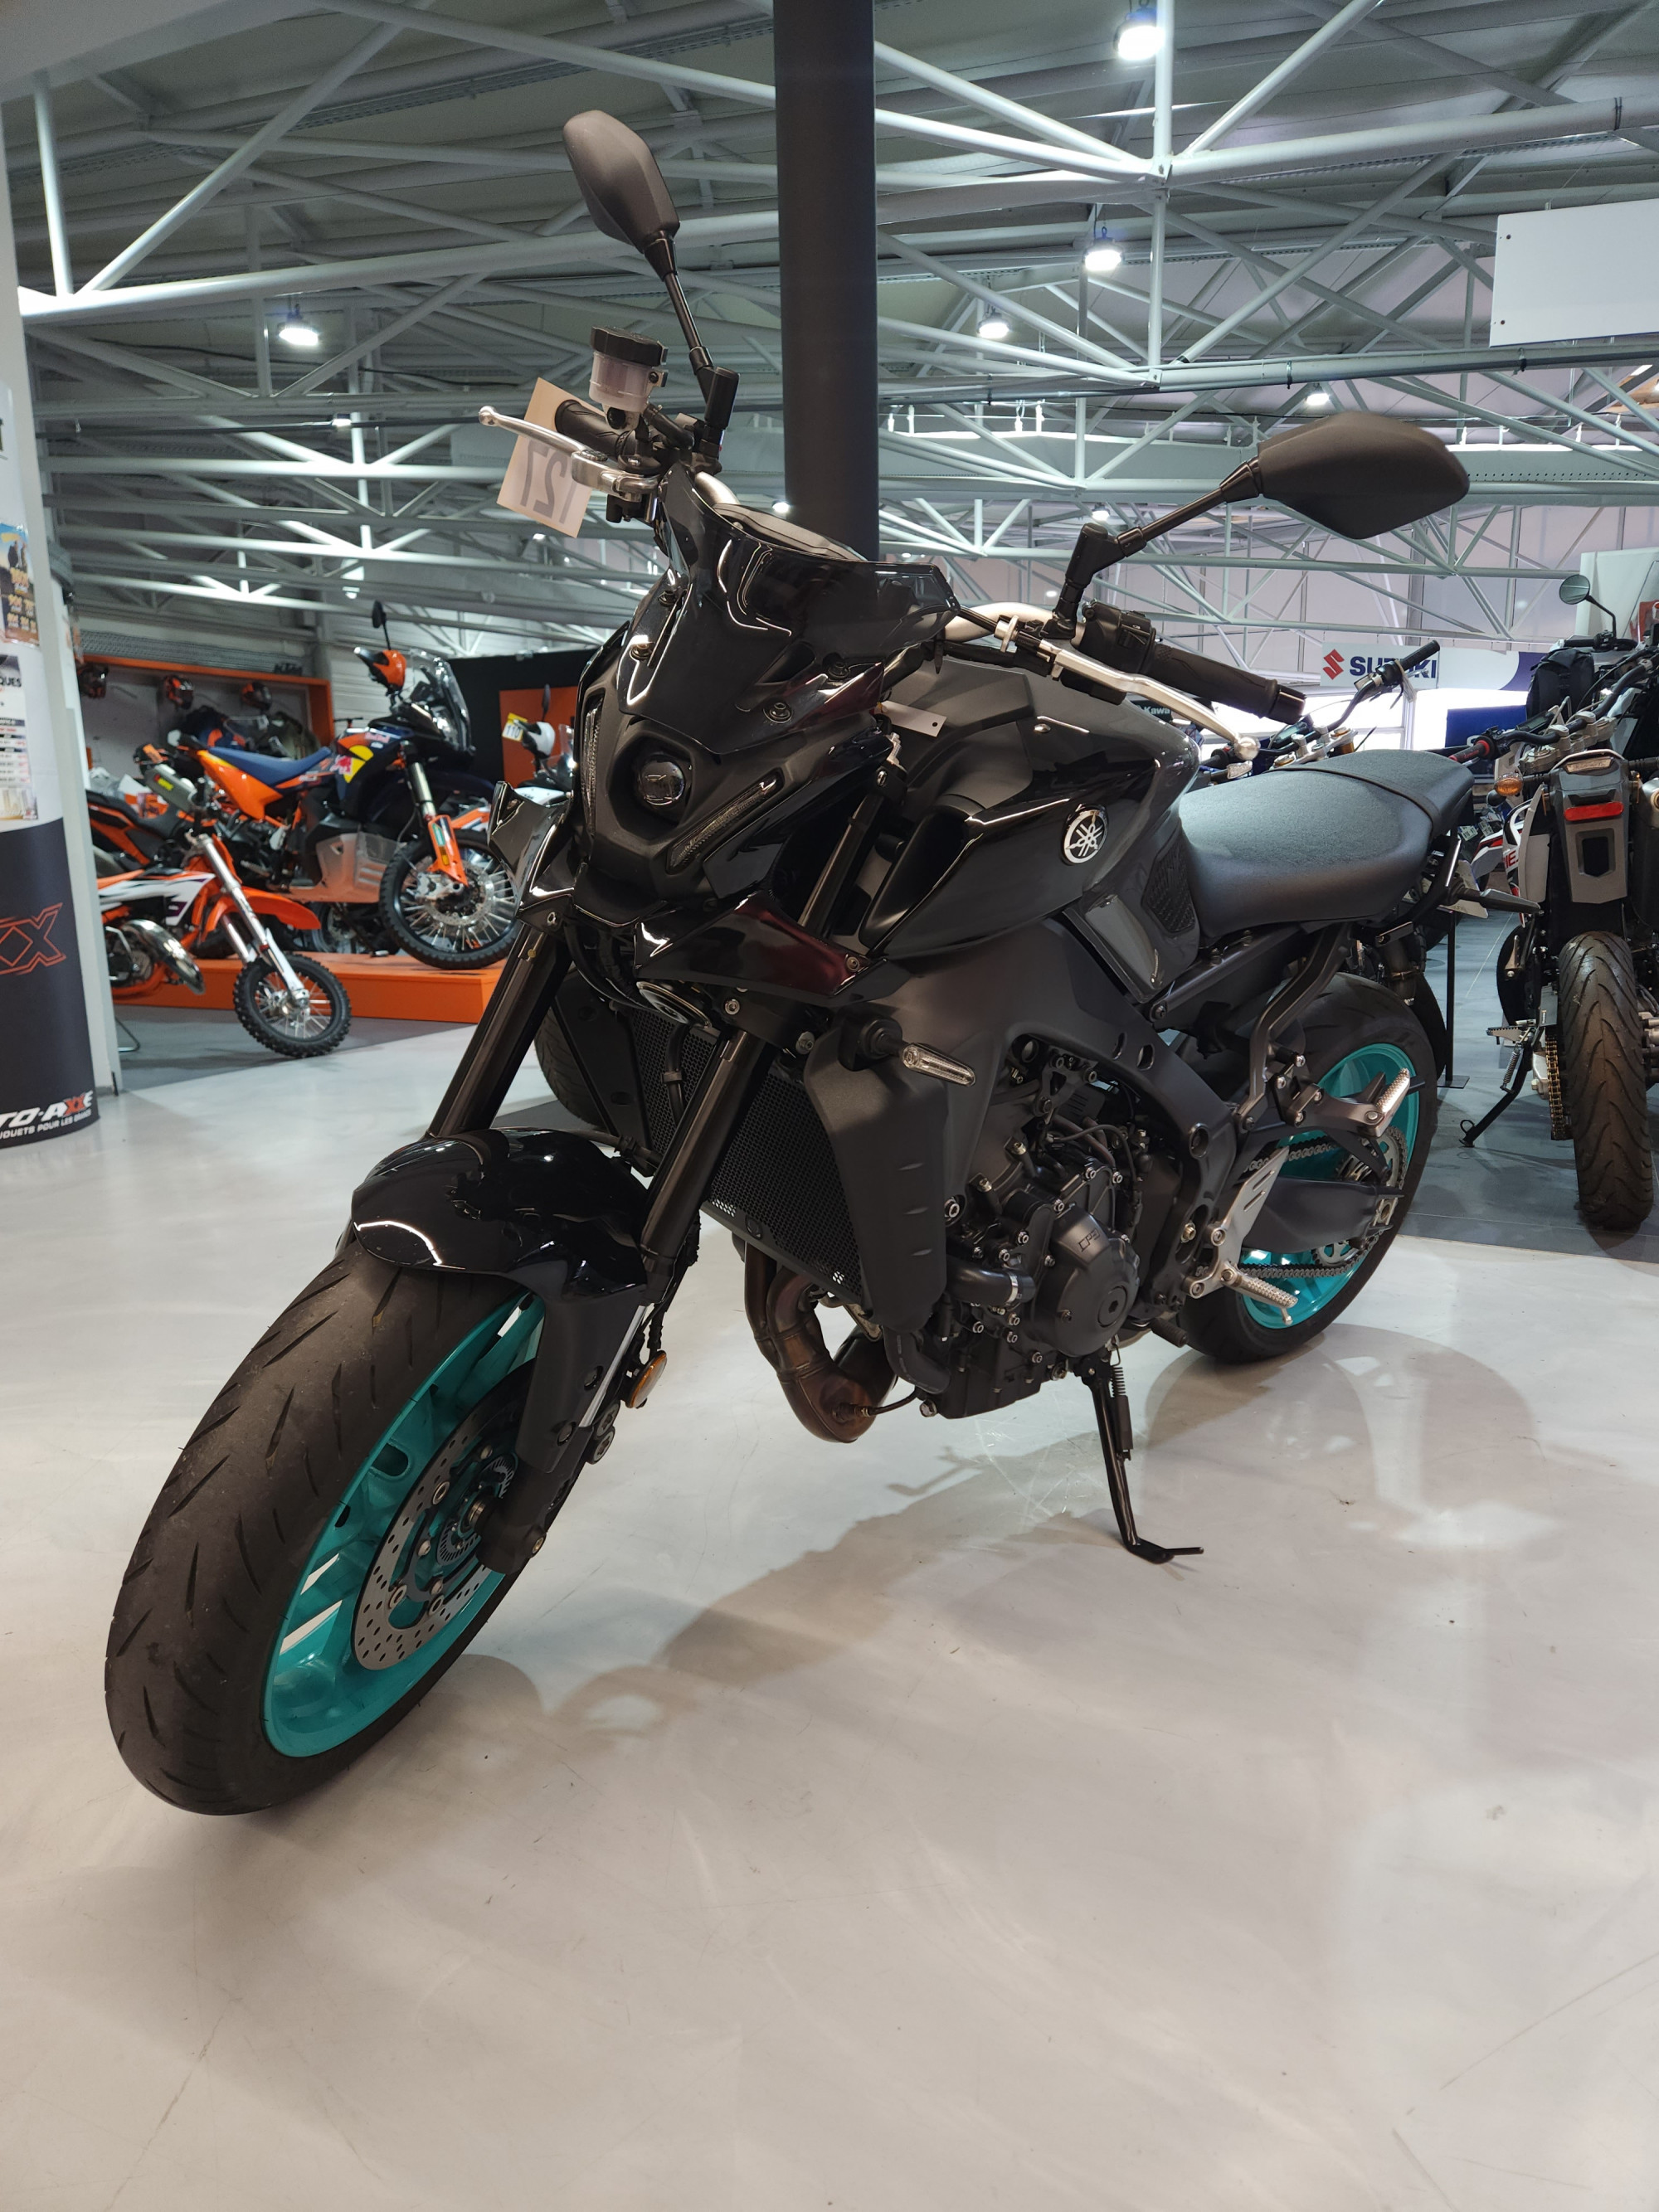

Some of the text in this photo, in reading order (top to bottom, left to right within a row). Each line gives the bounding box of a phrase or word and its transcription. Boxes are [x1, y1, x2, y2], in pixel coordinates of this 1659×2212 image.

[1350, 656, 1438, 678] SUKI
[37, 1120, 59, 1132] POUR
[61, 1116, 73, 1126] LES
